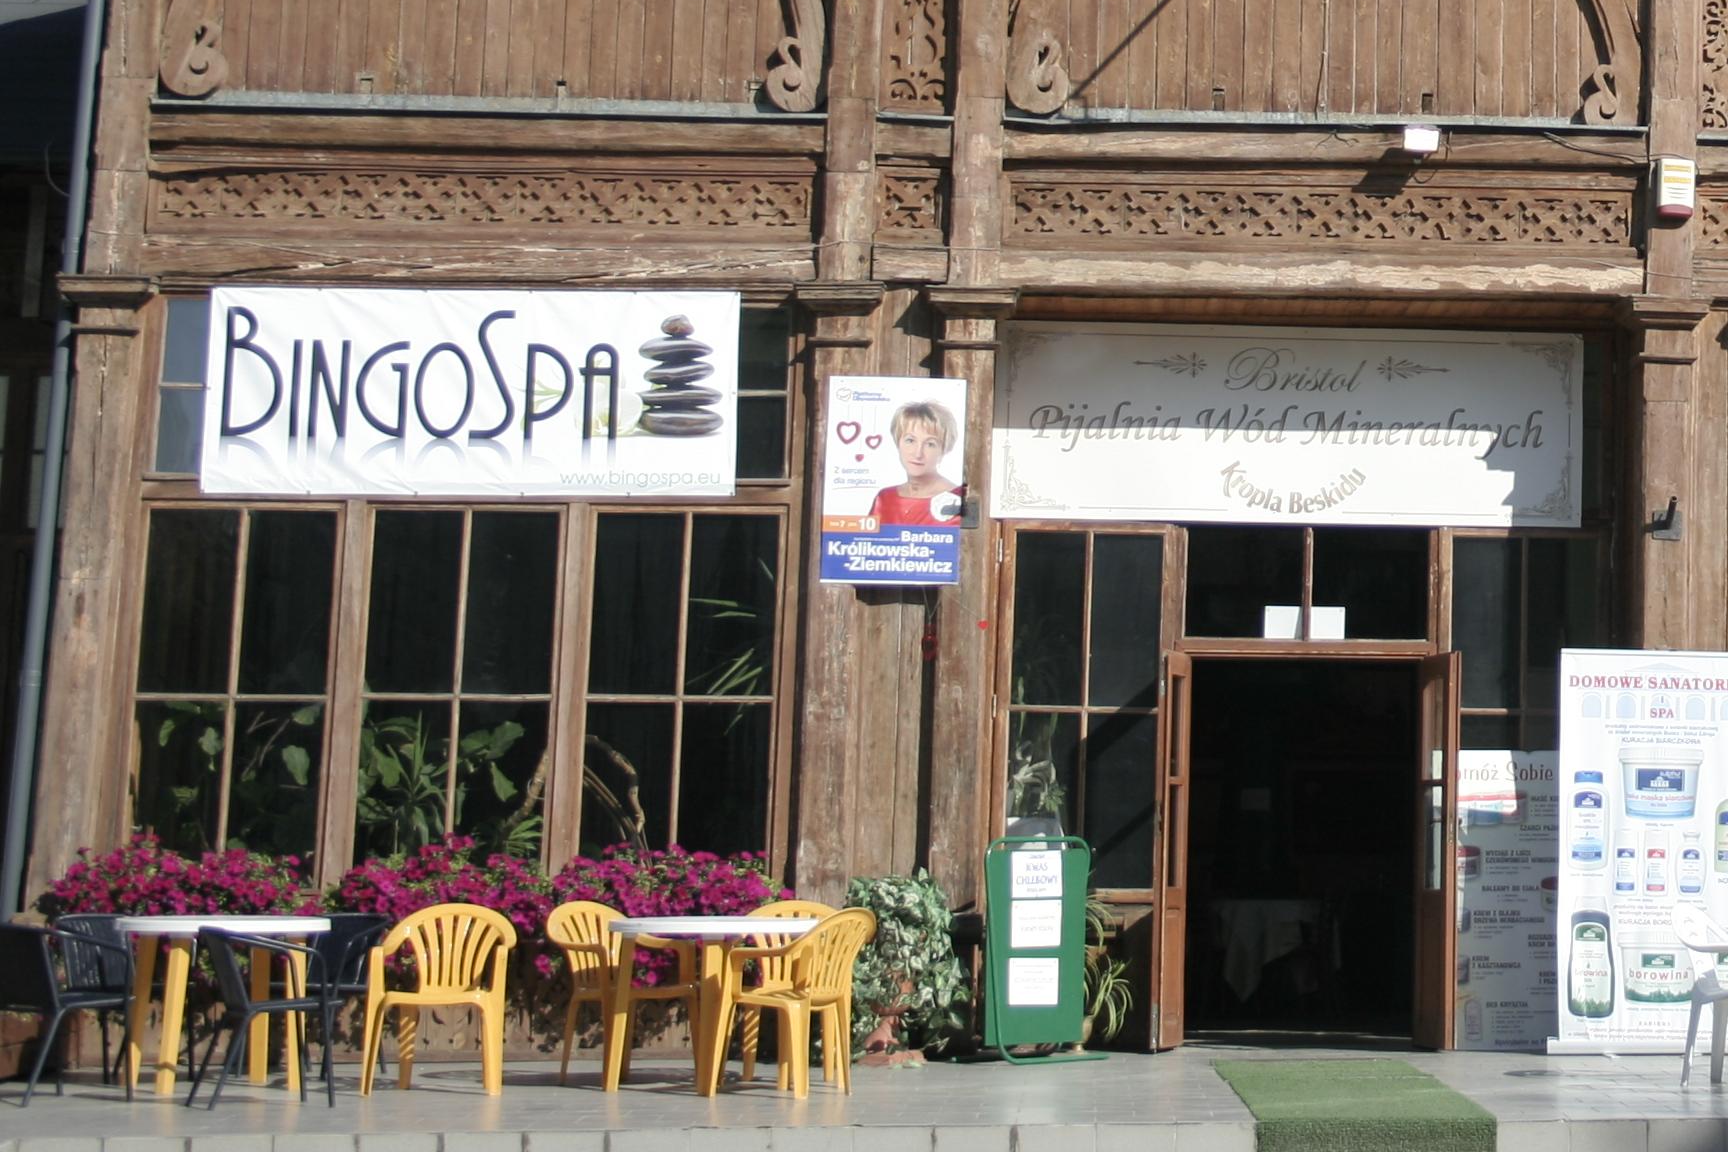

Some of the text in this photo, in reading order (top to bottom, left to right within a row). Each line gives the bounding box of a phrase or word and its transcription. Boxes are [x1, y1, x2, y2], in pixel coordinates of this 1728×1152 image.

[1224, 348, 1368, 393] Bristol
[1028, 401, 1545, 460] Pijalnia Wód Mineralnych
[560, 470, 720, 488] www.bingospa.eu
[1220, 460, 1366, 514] Kropla Beskidu
[859, 518, 876, 530] 10
[901, 531, 954, 543] Barbara
[828, 541, 935, 557] Królikowska-
[843, 557, 953, 573] -Ziemkiewicz
[1569, 675, 1643, 689] DOMOWE
[1650, 708, 1675, 718] SPA
[1505, 760, 1553, 782] Sobie
[1629, 968, 1688, 981] borowina
